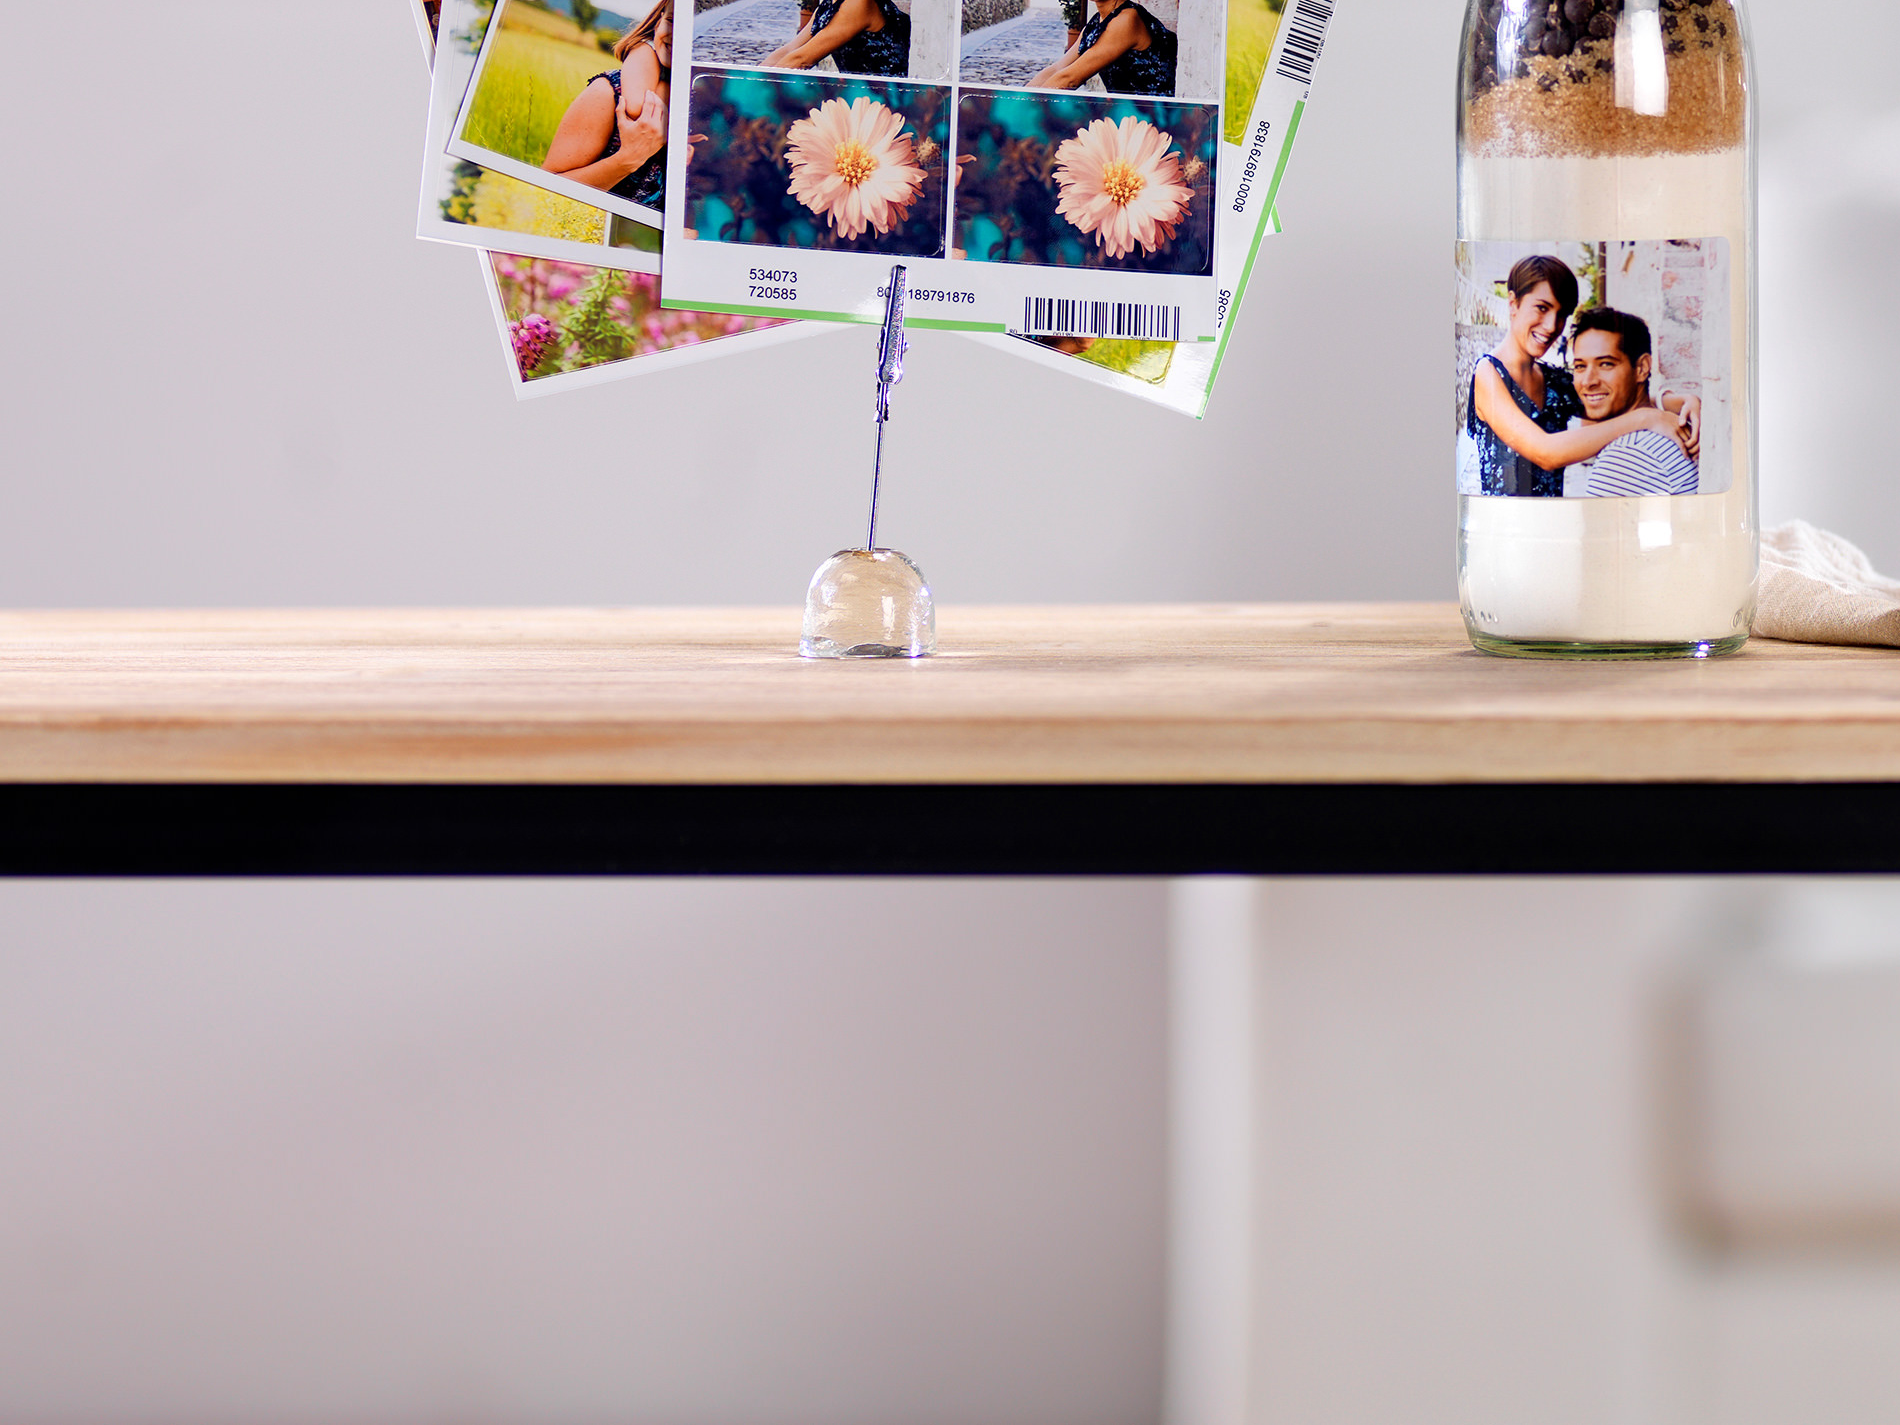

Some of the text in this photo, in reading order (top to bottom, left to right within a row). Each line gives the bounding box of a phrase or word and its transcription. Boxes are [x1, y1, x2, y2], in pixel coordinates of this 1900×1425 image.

[1232, 120, 1271, 213] 8000189791838
[749, 268, 798, 283] 534073
[748, 285, 797, 301] 720585
[876, 286, 976, 304] 80189791876
